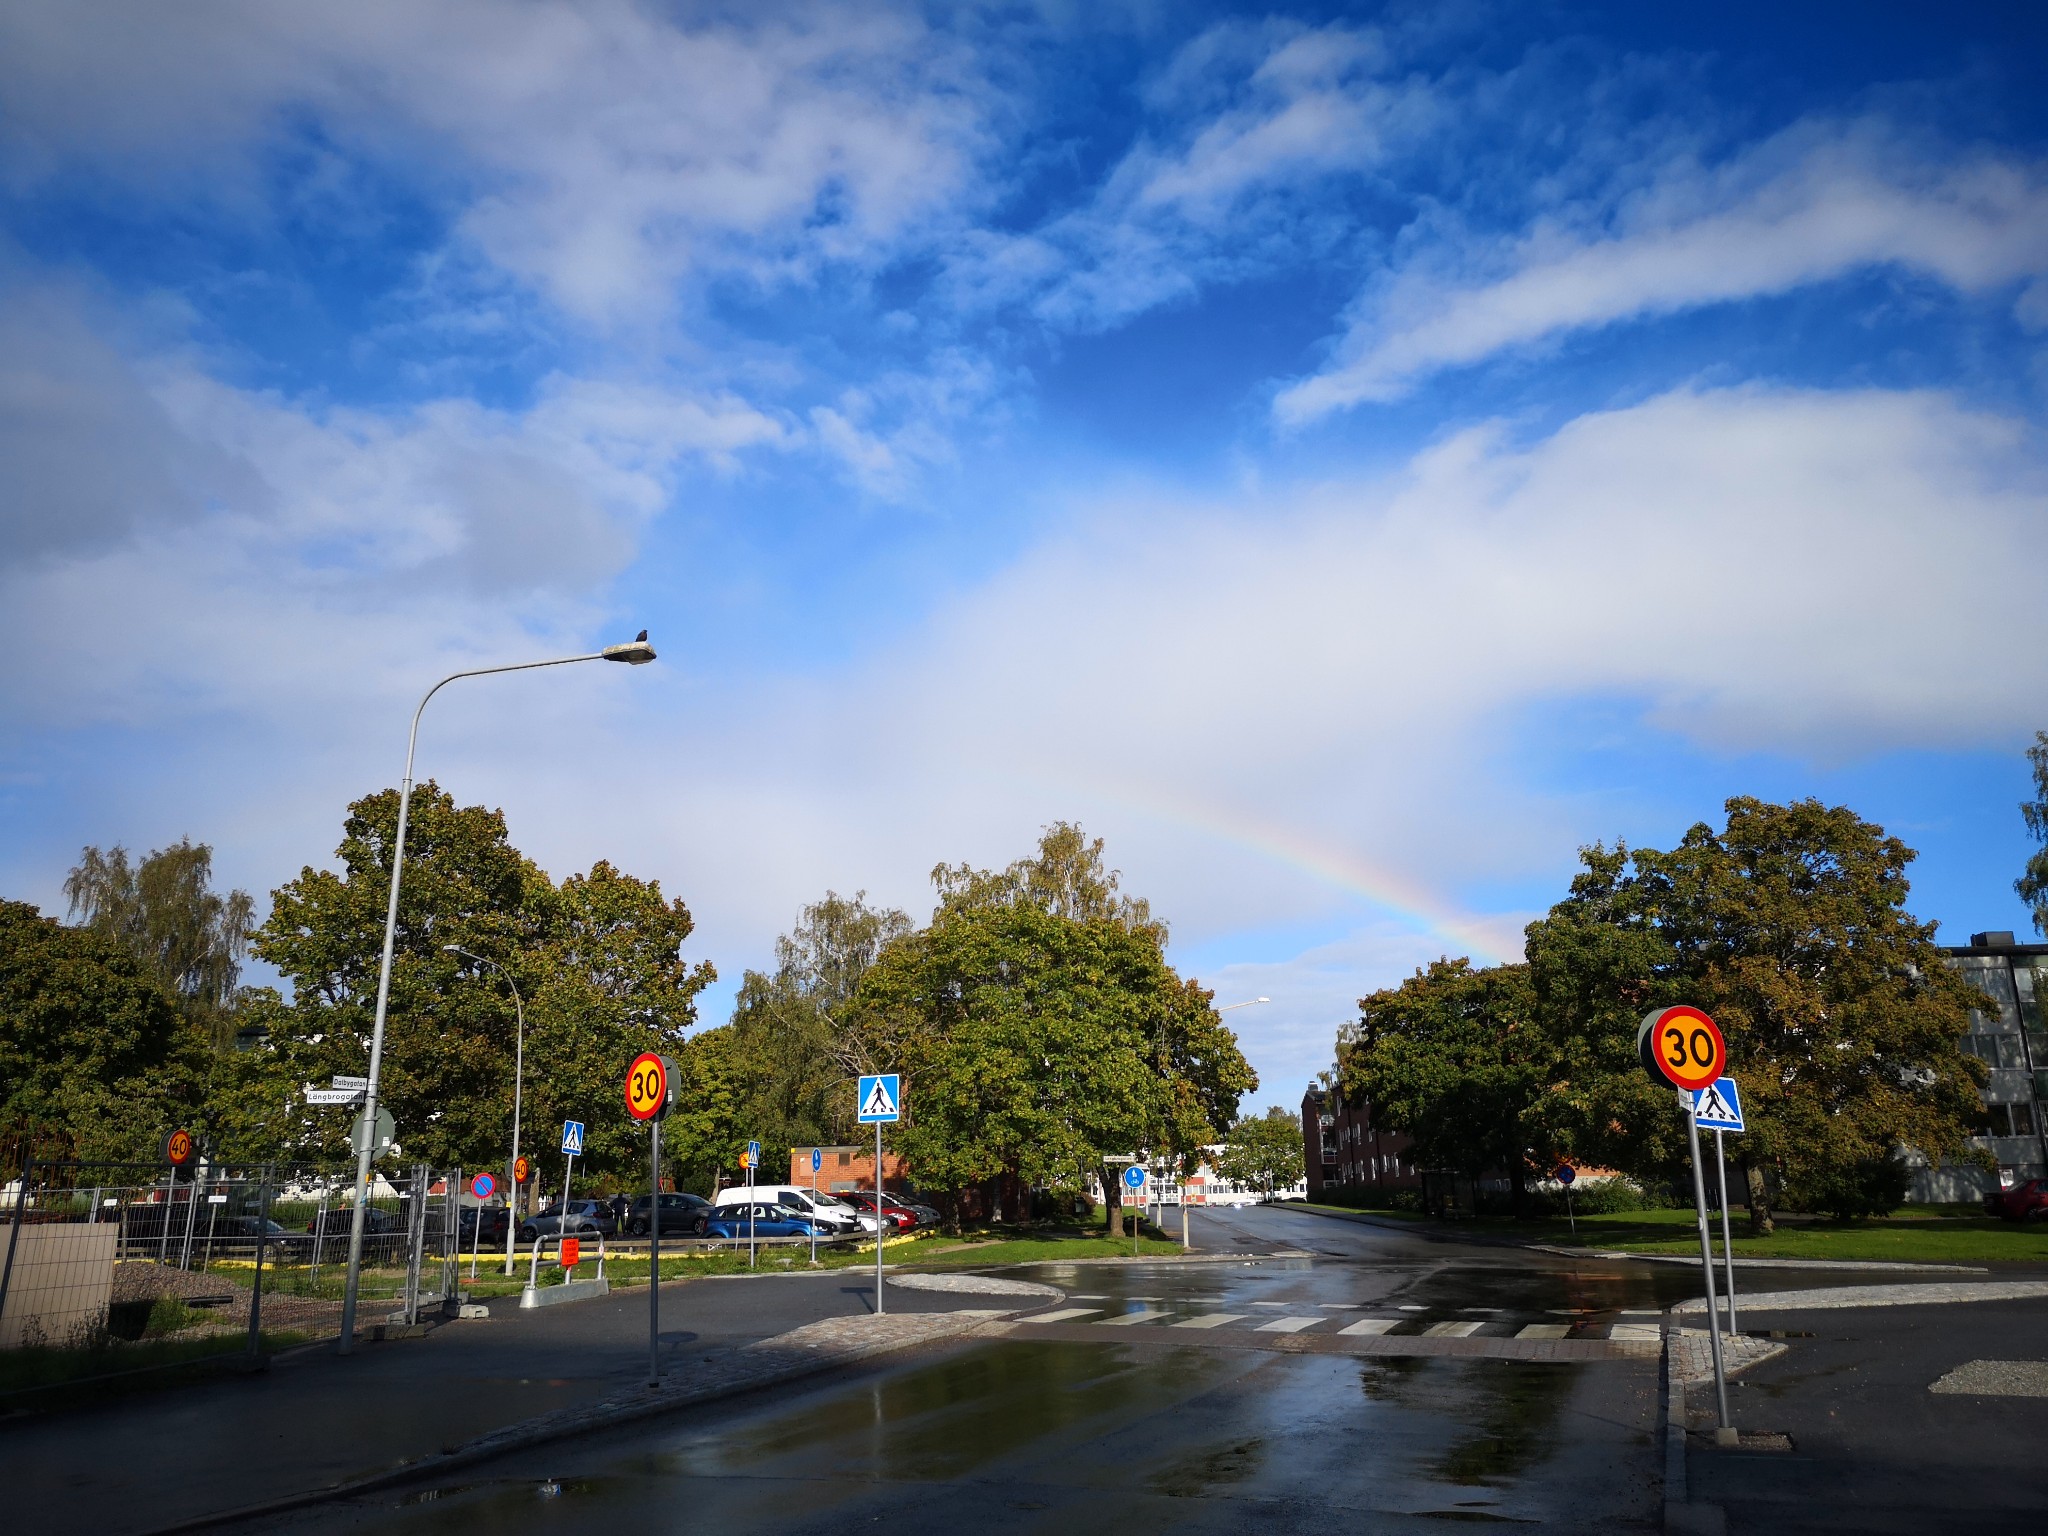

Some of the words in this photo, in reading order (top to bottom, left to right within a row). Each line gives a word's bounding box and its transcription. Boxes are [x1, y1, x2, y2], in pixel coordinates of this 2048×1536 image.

[1665, 1028, 1714, 1068] 30
[334, 1078, 366, 1088] Dalbygatan
[633, 1069, 660, 1103] 30
[171, 1138, 187, 1155] 40
[515, 1163, 526, 1176] 40
